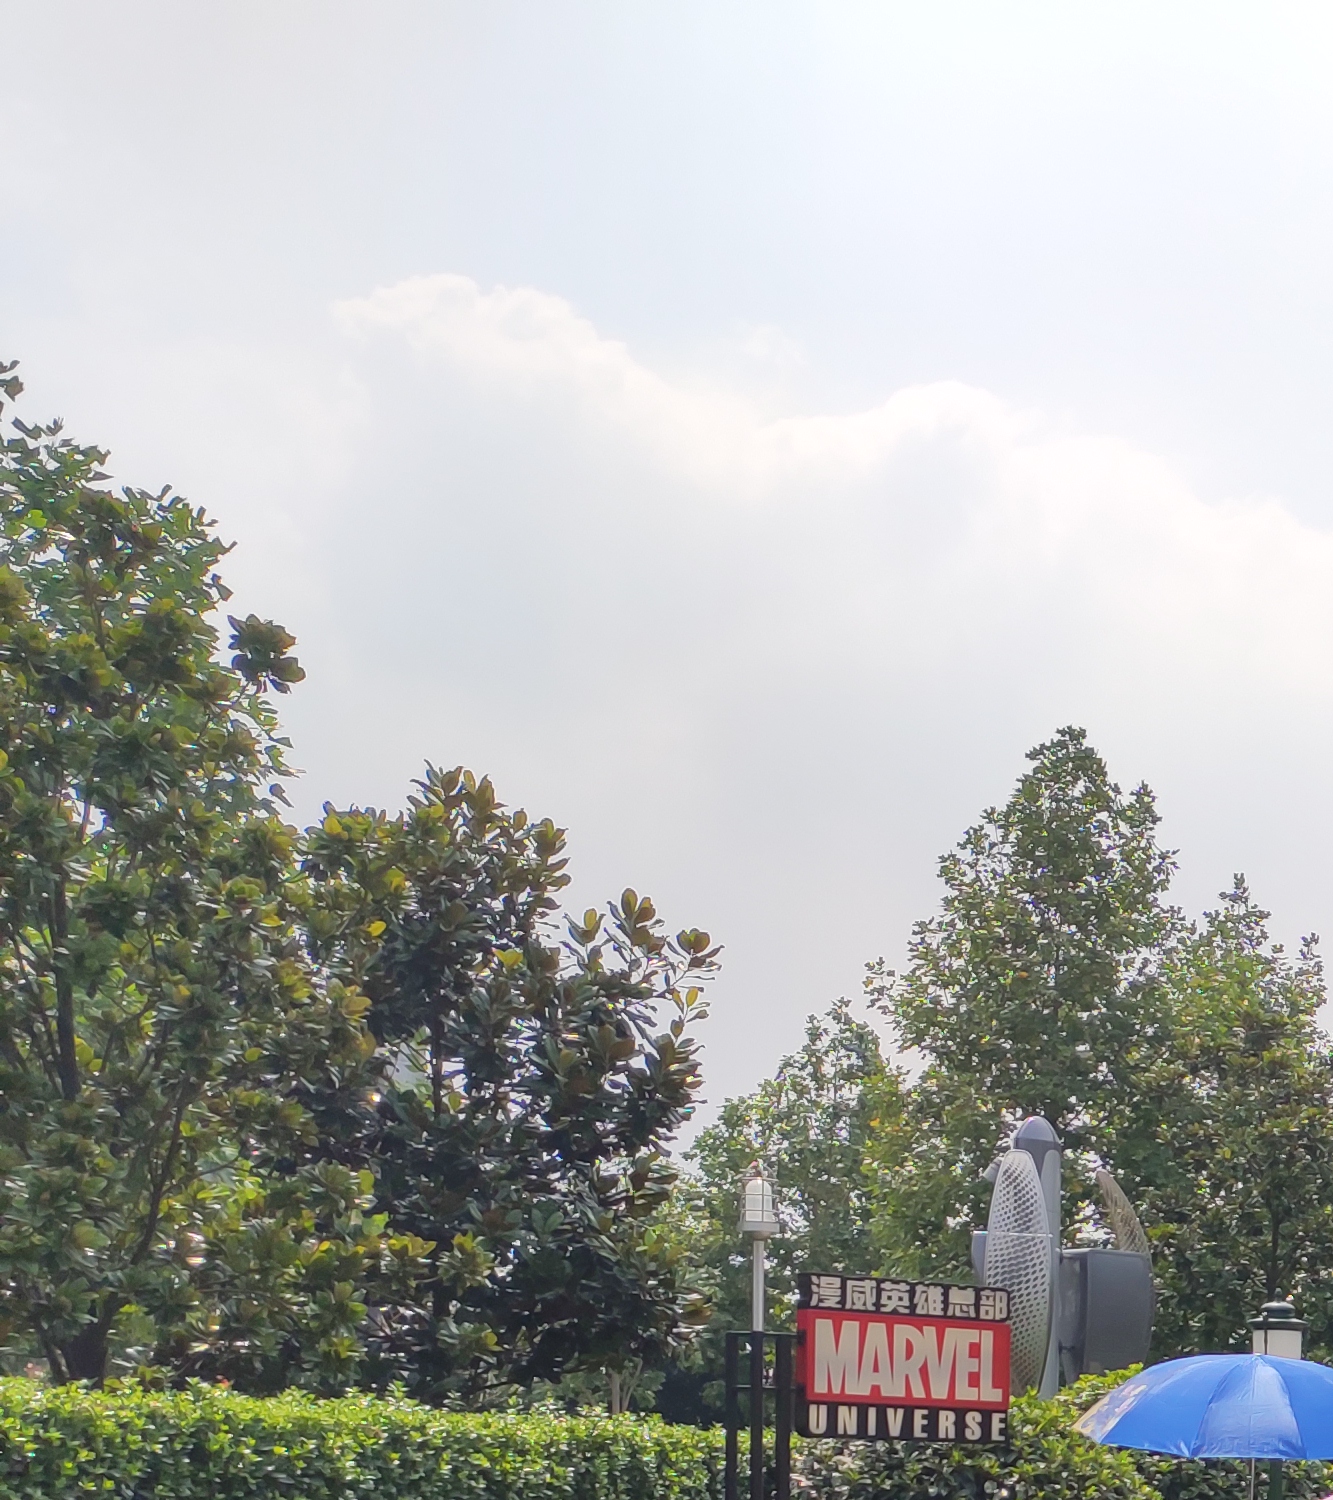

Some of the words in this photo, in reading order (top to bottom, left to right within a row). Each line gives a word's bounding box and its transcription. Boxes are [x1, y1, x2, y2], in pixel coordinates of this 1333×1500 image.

[810, 1275, 1008, 1320] 漫威英雄总部
[814, 1318, 1002, 1402] MARVEL
[808, 1404, 1006, 1441] UNIVERSE
